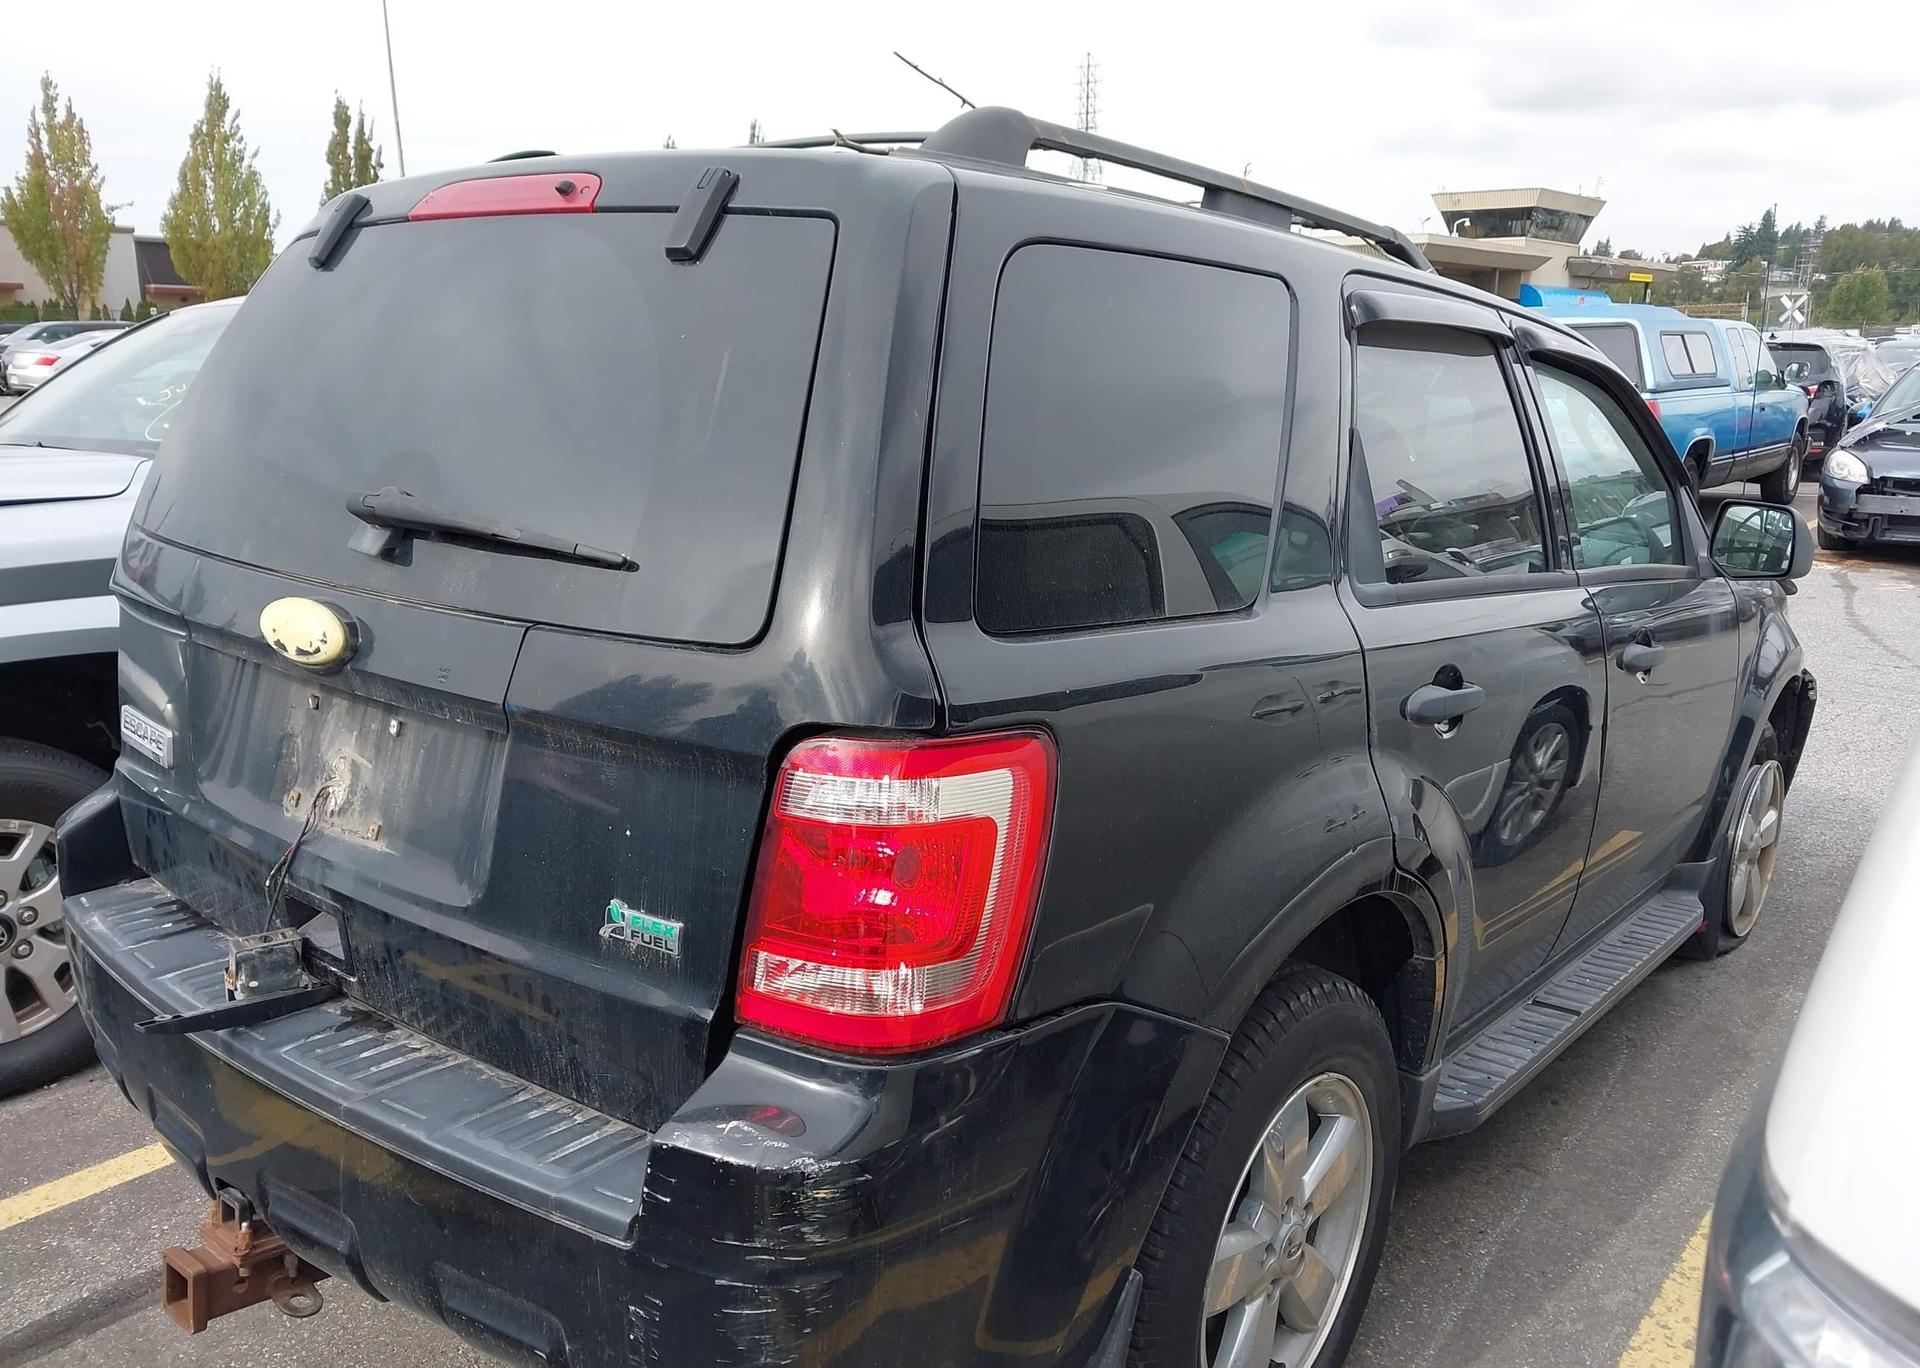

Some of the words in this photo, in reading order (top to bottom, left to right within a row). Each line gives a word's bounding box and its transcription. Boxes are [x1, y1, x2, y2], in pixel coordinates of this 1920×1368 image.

[123, 713, 164, 752] ESCAPE
[631, 915, 675, 938] FLEX
[630, 929, 674, 953] FUEL
